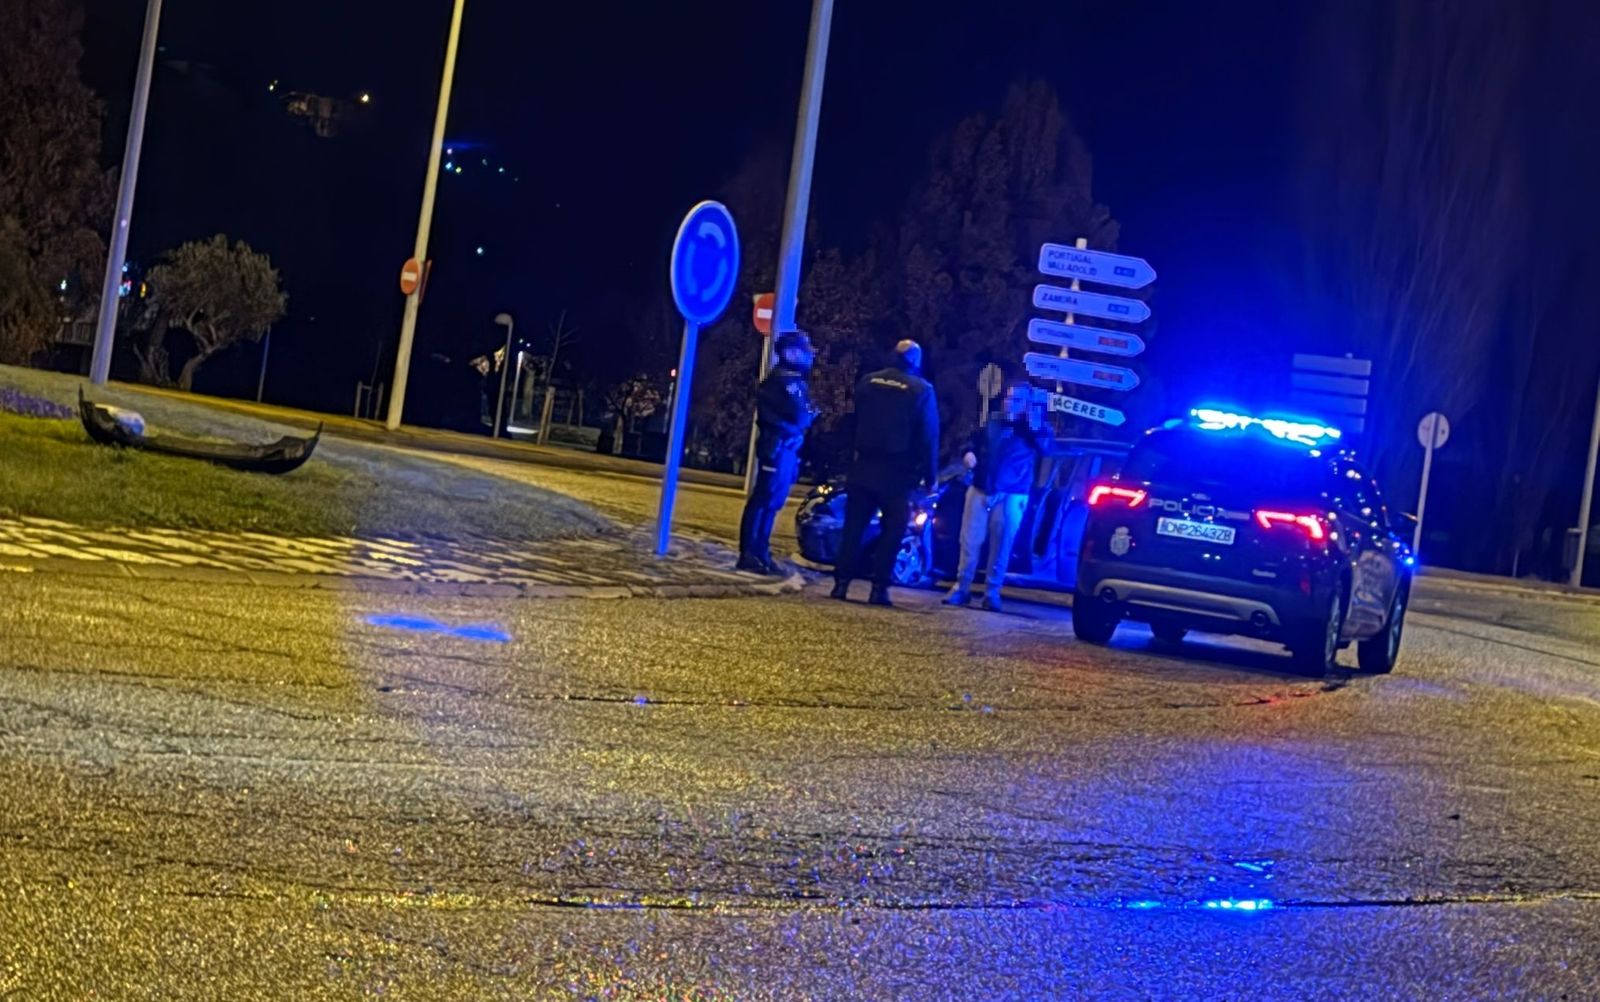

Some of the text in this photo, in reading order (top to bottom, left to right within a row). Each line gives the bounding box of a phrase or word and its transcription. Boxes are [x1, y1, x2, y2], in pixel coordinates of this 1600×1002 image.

[1047, 250, 1092, 264] PORTUGAL
[1047, 261, 1098, 276] VALLADOLID
[1053, 397, 1106, 419] ACERES
